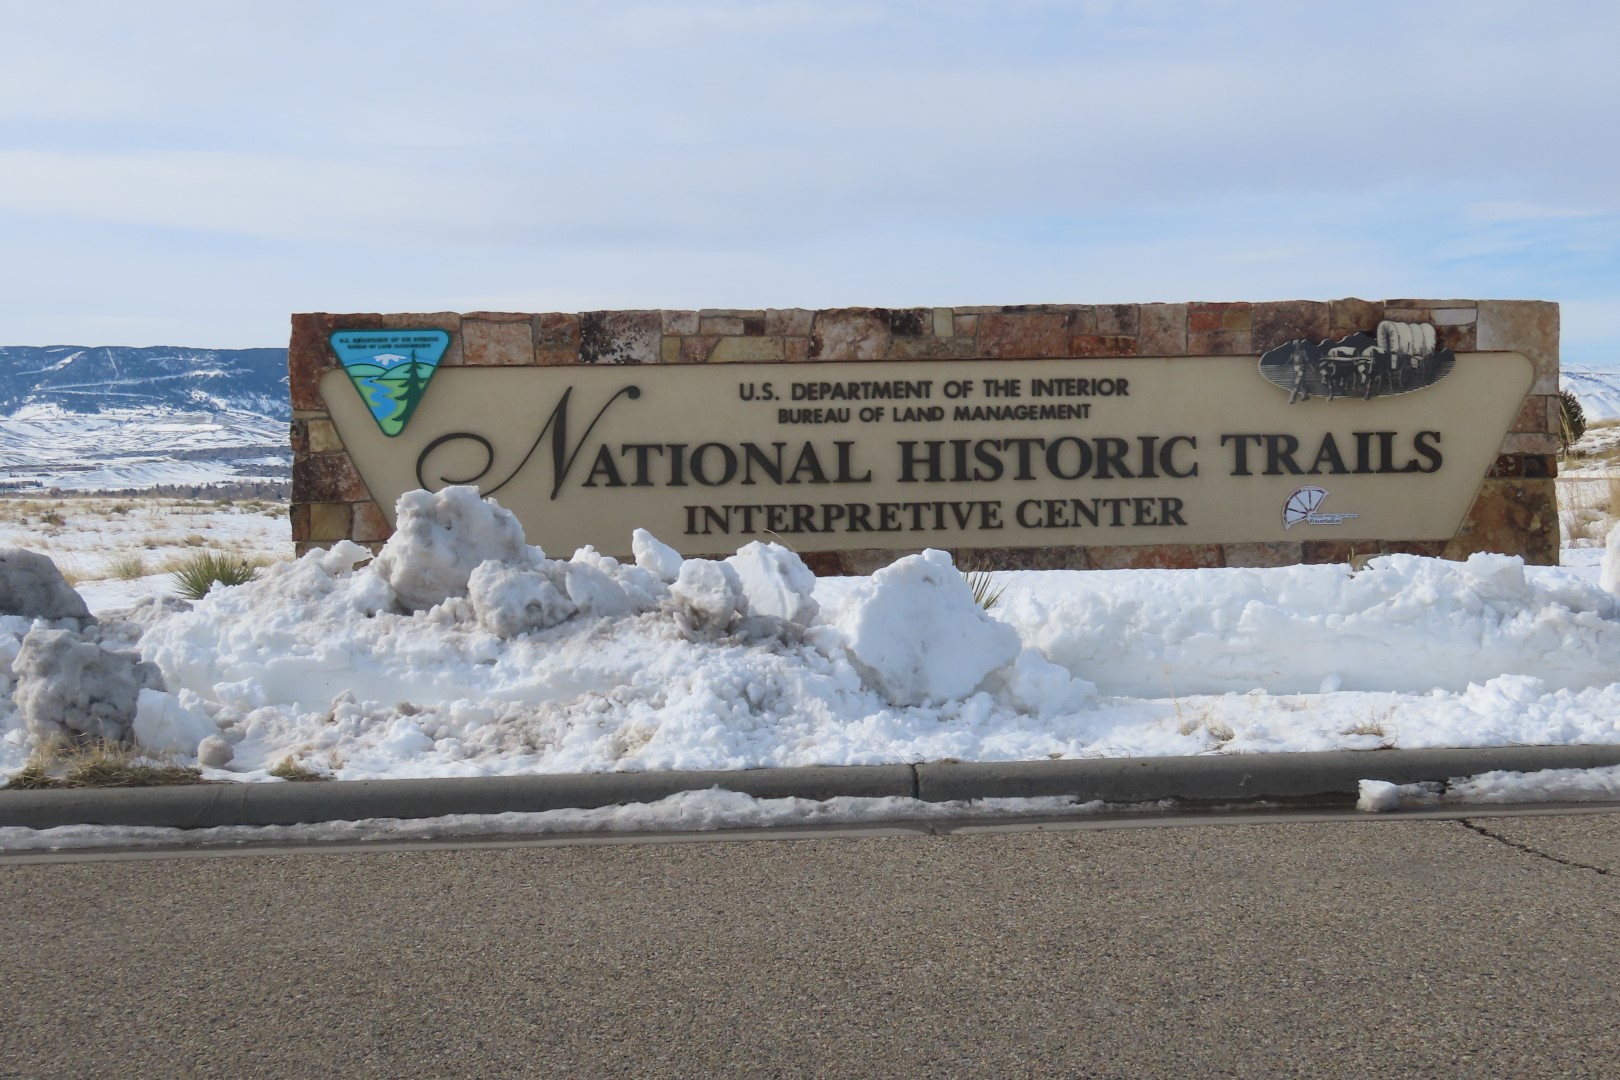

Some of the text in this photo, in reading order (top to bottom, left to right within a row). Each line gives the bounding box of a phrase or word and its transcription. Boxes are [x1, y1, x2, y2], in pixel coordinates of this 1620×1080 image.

[739, 378, 1129, 401] U.S. DEPARTMENT OF THE INTERIOR
[778, 404, 1091, 424] BUREAU OF LAND MANAGEMENT
[416, 386, 1442, 501] NATIONAL HISTORIC TRAILS
[685, 497, 1188, 534] INTERPRETIVE CENTER
